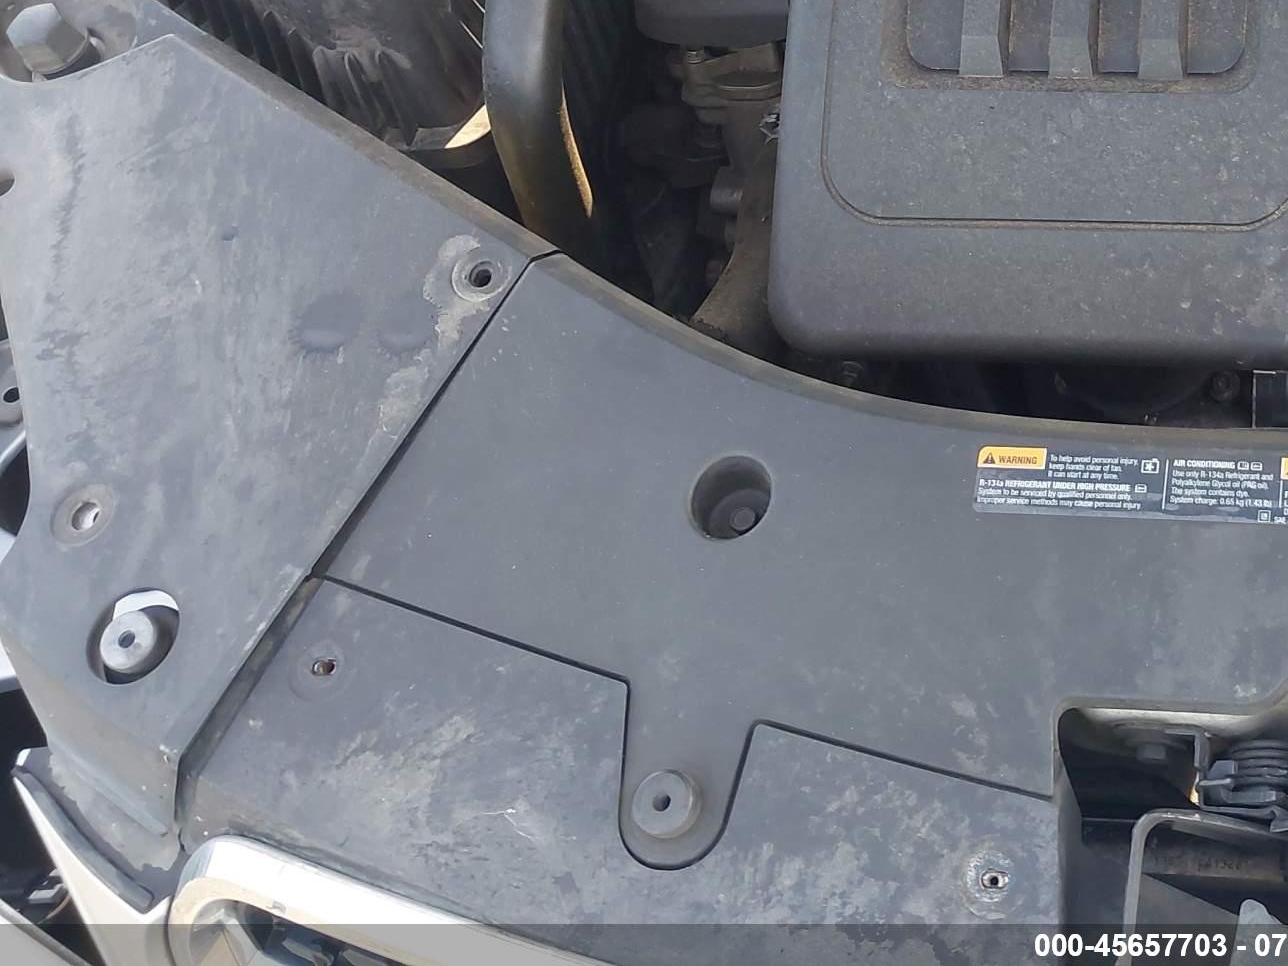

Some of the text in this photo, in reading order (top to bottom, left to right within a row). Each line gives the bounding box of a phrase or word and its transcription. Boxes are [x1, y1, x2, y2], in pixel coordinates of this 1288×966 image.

[999, 455, 1037, 465] WARNING
[1051, 454, 1058, 462] To
[1059, 455, 1072, 464] help
[1073, 455, 1091, 464] avoid
[1091, 456, 1119, 465] personal
[1173, 459, 1236, 470] AIR CONDITIONING
[1048, 462, 1065, 471] keep
[1065, 463, 1085, 471] hands
[1086, 464, 1102, 472] clear
[1102, 464, 1110, 473] of
[1067, 471, 1081, 479] start
[1090, 472, 1102, 481] any
[1186, 471, 1200, 479] only
[1200, 471, 1224, 479] R-134a
[1225, 472, 1260, 481] Refrigerant
[1260, 473, 1274, 481] and
[980, 479, 1131, 492] R-134a REFRIGERANT UNDER HIGH PRESSURE
[1171, 478, 1212, 487] Polyalkylene
[1212, 479, 1231, 488] Glycol
[1232, 480, 1240, 488] oil
[1241, 481, 1257, 489] (PAG
[978, 487, 1002, 496] System
[1002, 488, 1010, 496] to
[1020, 489, 1047, 497] serviced
[1048, 490, 1056, 499] by
[1057, 491, 1084, 500] qualified
[1085, 492, 1117, 501] personnel
[1171, 486, 1183, 494] The
[1184, 488, 1207, 496] system
[1208, 489, 1235, 497] contains
[977, 496, 1006, 505] Improper
[1030, 498, 1058, 506] methods
[1060, 500, 1073, 508] may
[1094, 501, 1122, 509] personal
[1170, 495, 1194, 504] System
[1219, 498, 1235, 506] 0.65
[1236, 498, 1244, 507] kg
[1245, 499, 1262, 507] (1.43
